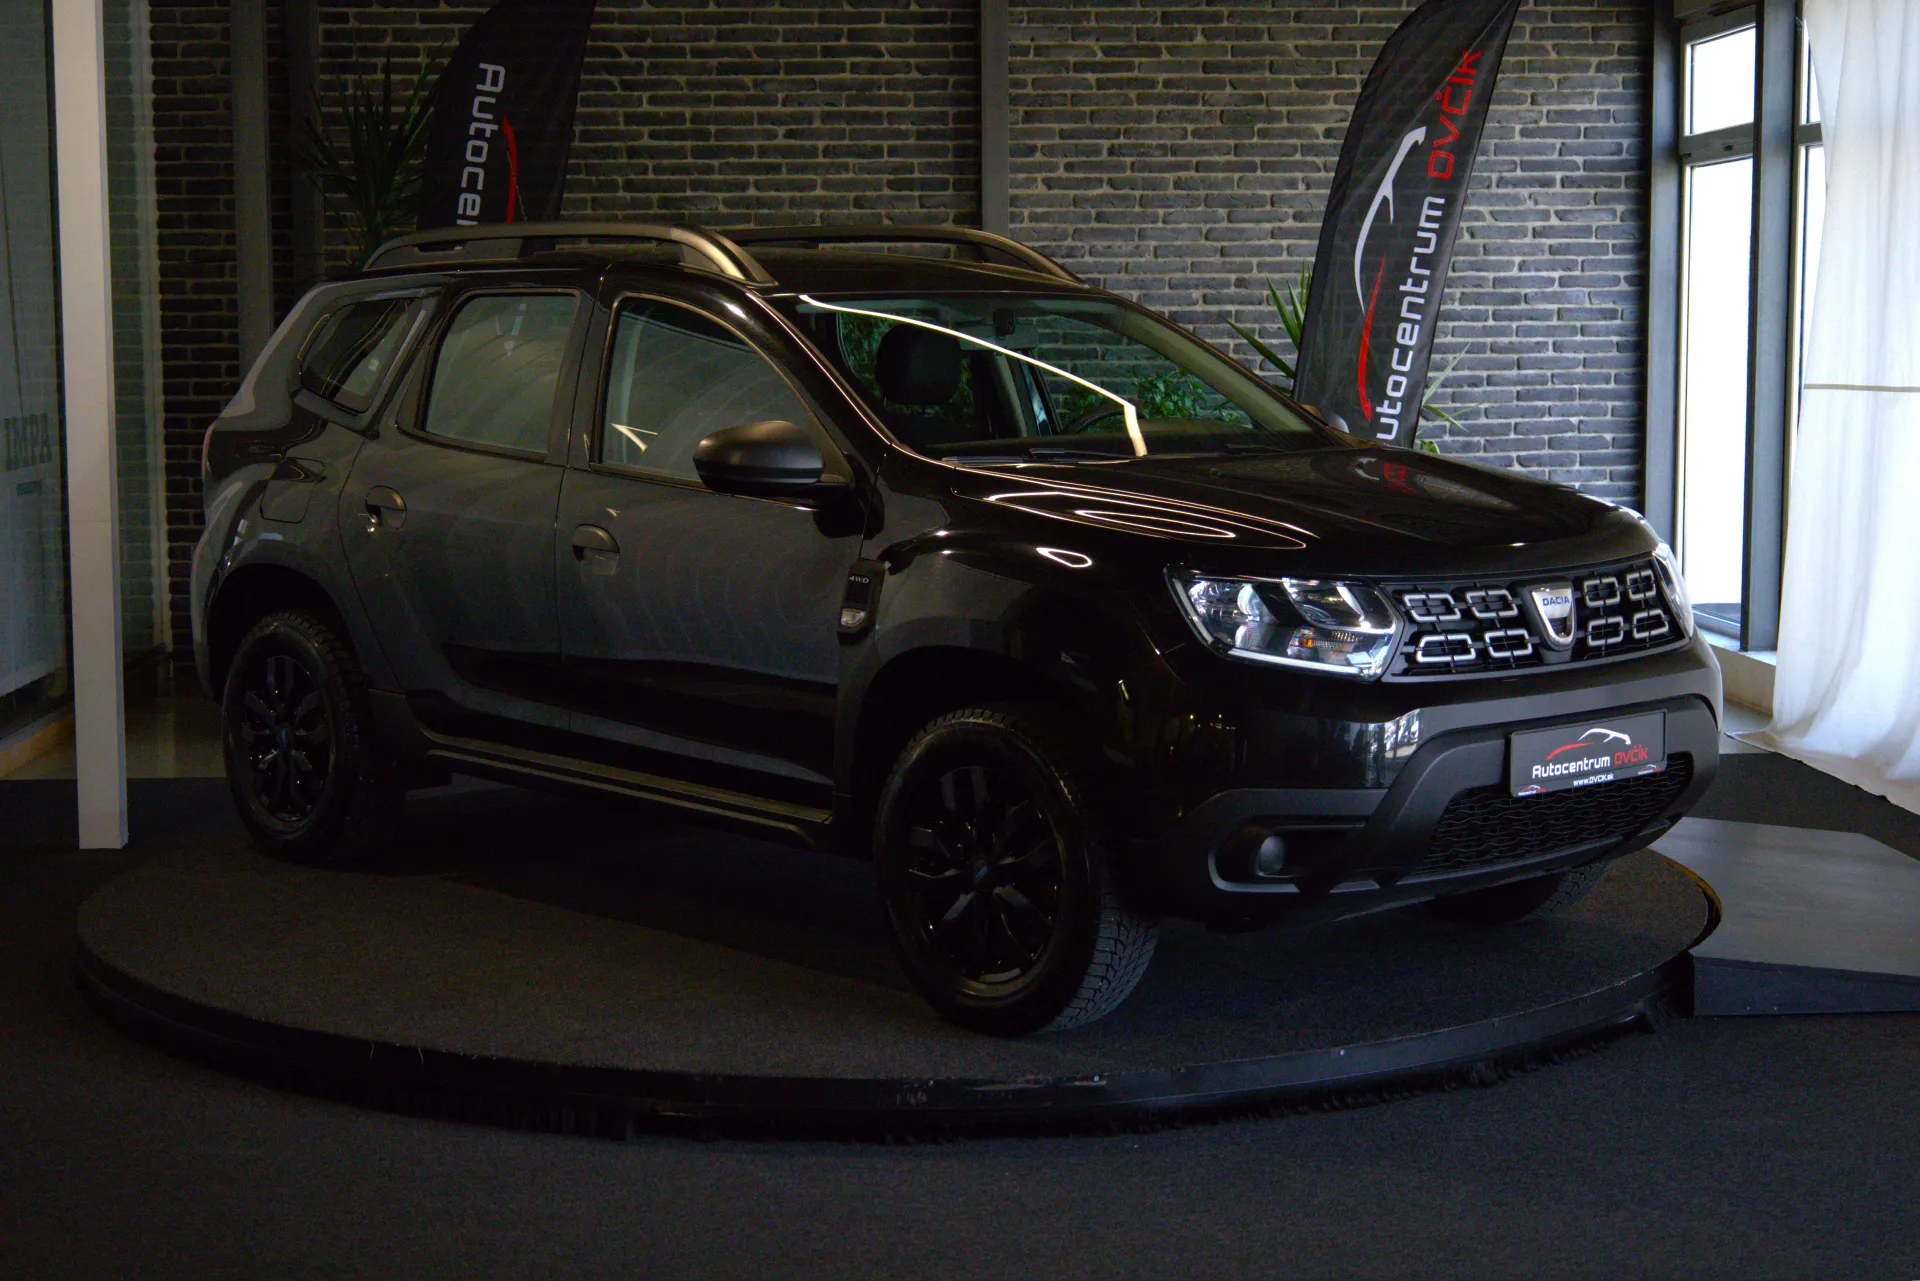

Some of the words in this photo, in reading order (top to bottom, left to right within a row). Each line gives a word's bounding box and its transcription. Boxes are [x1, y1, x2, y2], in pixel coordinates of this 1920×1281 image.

[456, 62, 506, 226] Autoce
[1375, 196, 1445, 440] utocentrum
[849, 575, 870, 584] 4WD
[1542, 595, 1570, 606] DACIA
[1532, 755, 1611, 779] Autocentrum
